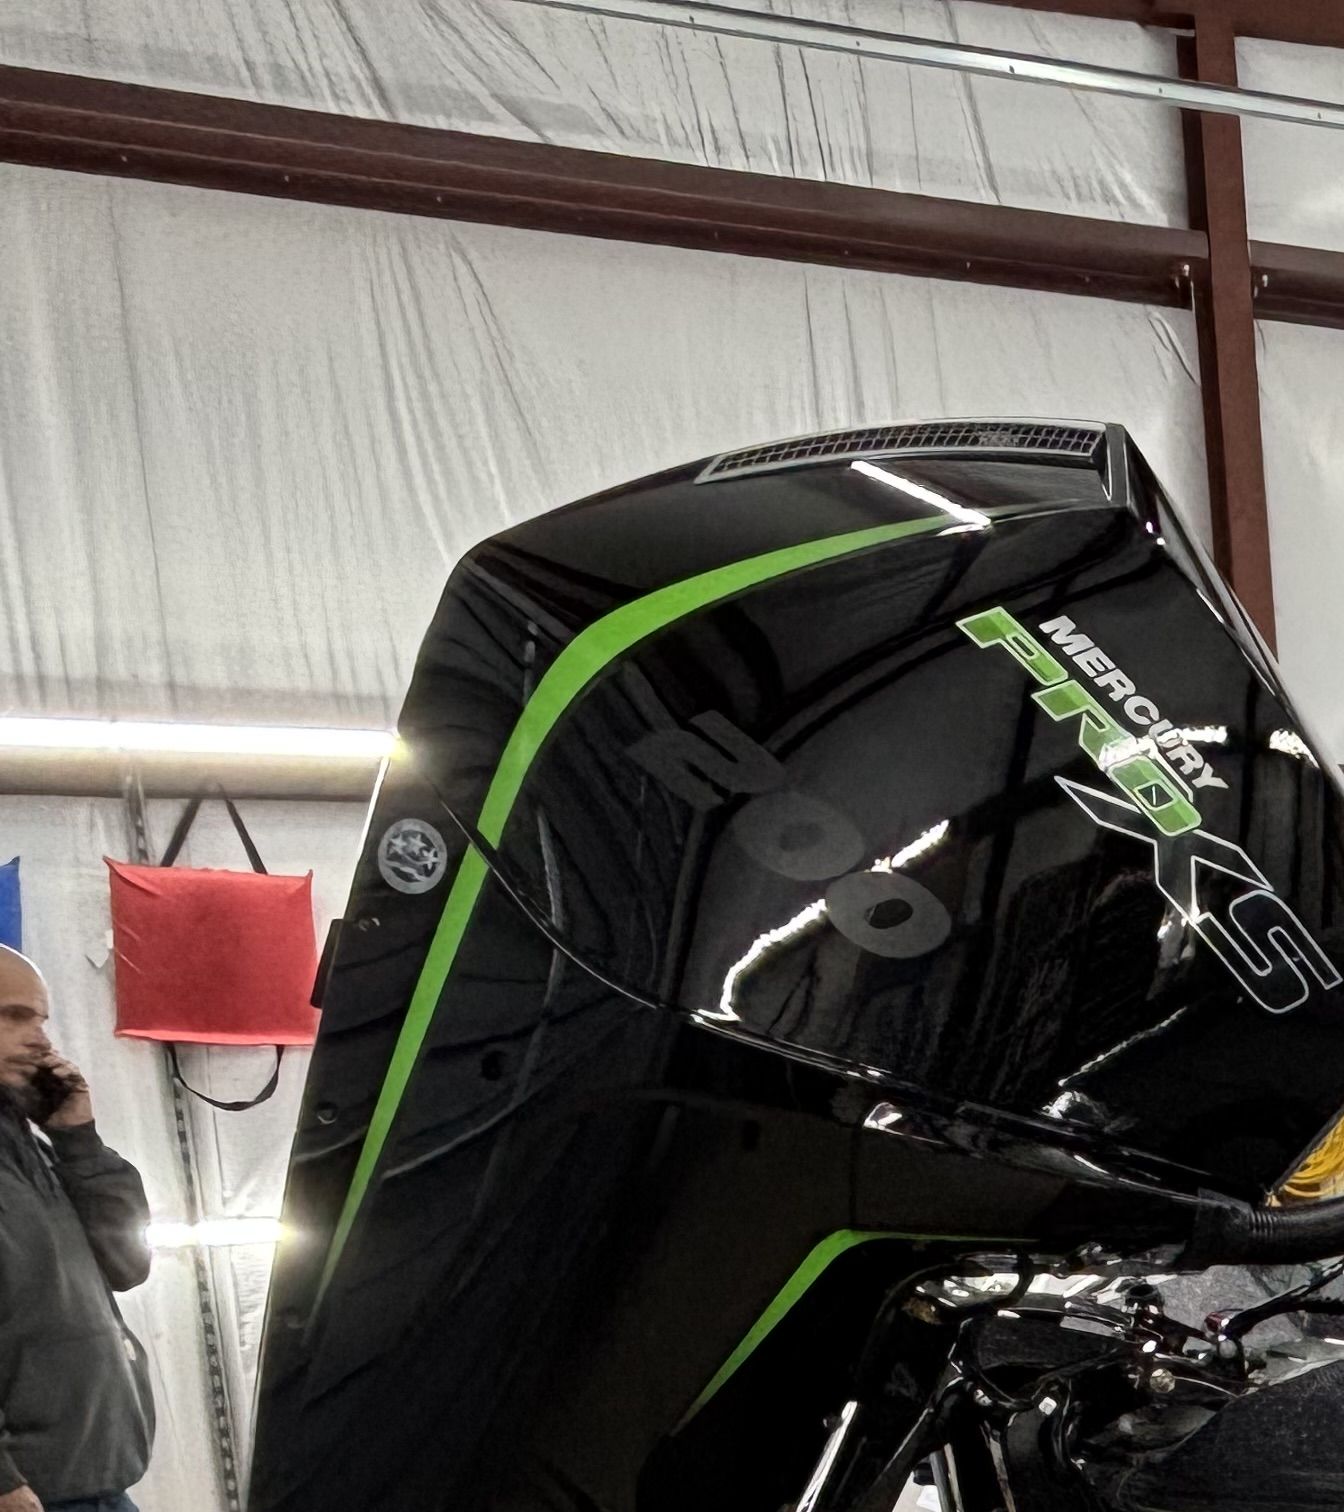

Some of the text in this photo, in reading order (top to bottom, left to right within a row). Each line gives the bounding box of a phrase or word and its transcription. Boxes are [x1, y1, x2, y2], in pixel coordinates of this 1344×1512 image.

[956, 607, 1343, 1014] PRO XS
[1039, 616, 1229, 790] MERCURY
